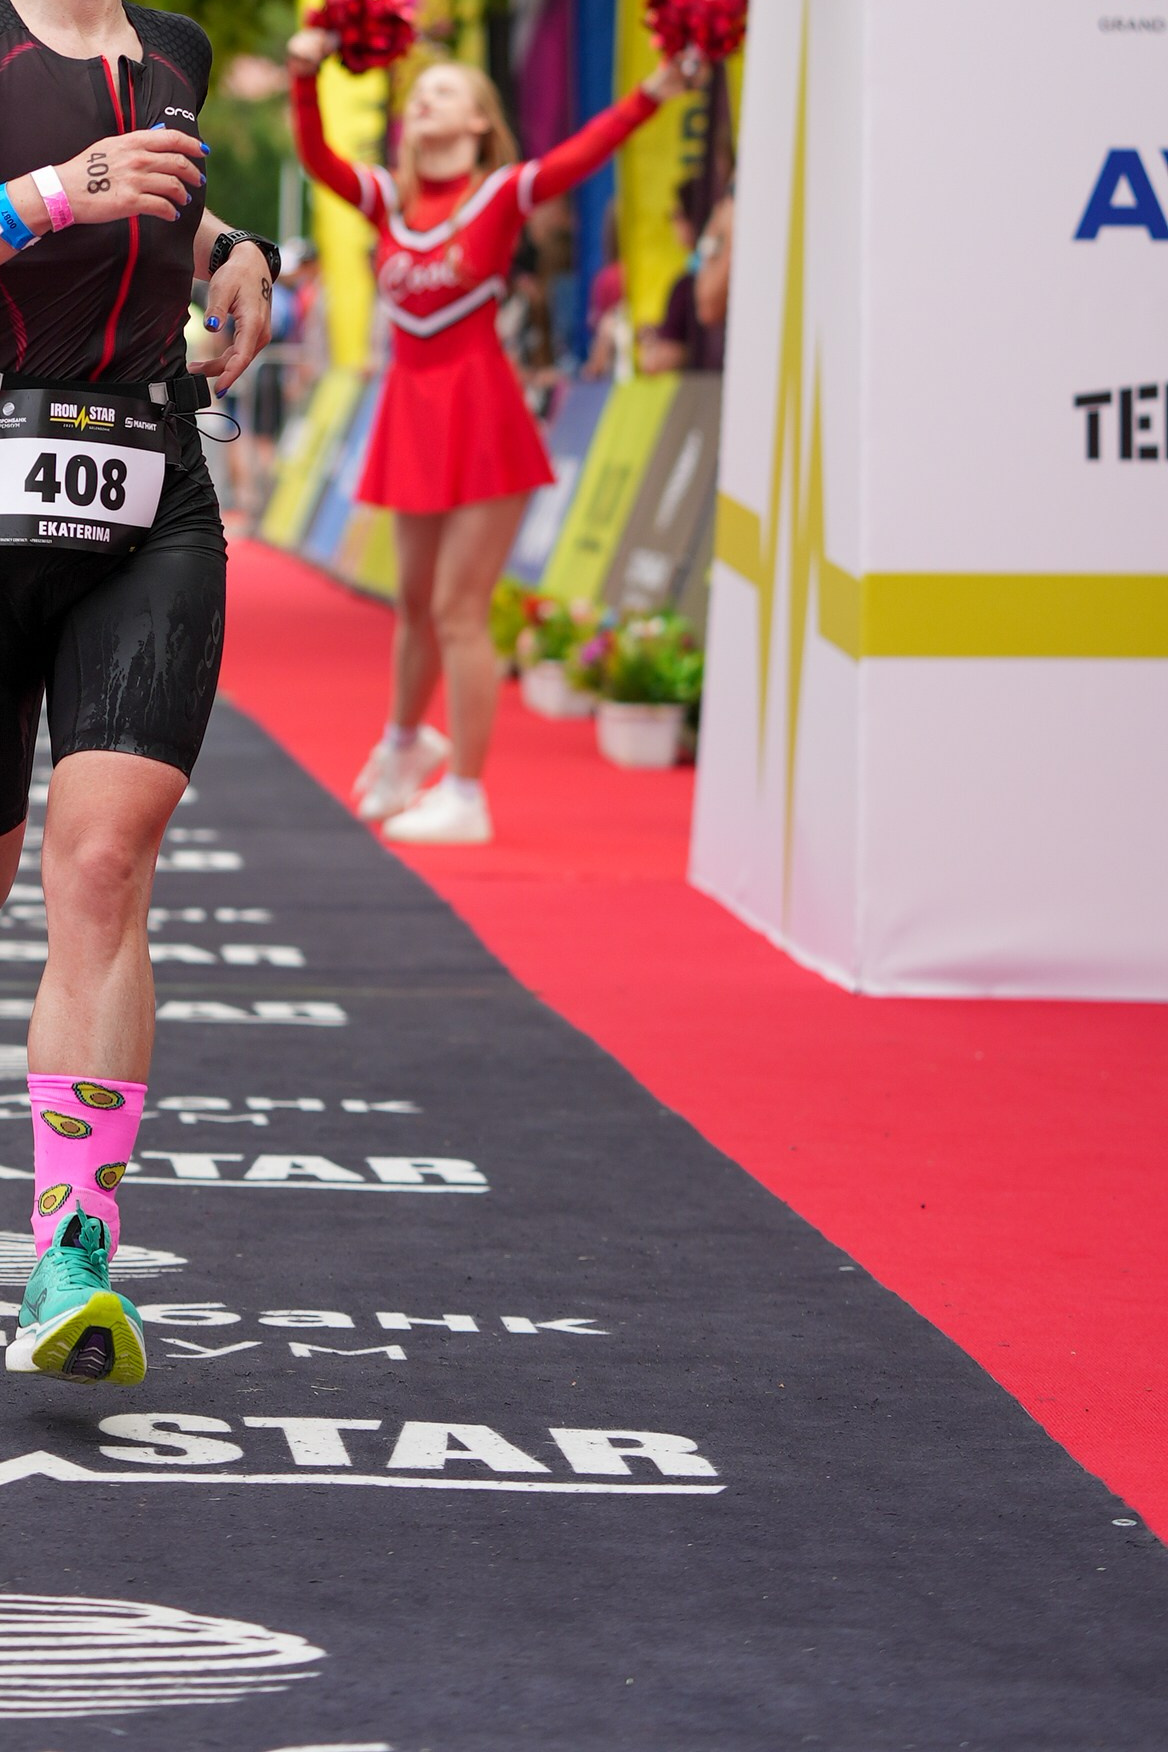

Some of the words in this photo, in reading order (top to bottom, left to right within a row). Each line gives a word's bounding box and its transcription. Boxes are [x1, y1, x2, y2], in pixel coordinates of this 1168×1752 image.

[164, 106, 195, 122] orca
[86, 152, 111, 195] 408
[1073, 148, 1168, 240] A
[50, 402, 78, 418] IRON
[89, 406, 116, 422] STAR
[133, 420, 157, 431] МАГНИТ
[1074, 383, 1168, 460] TE
[24, 452, 128, 511] 408
[38, 520, 111, 542] EKATERINA
[130, 1151, 488, 1185] TAR
[98, 1412, 718, 1476] STAR
